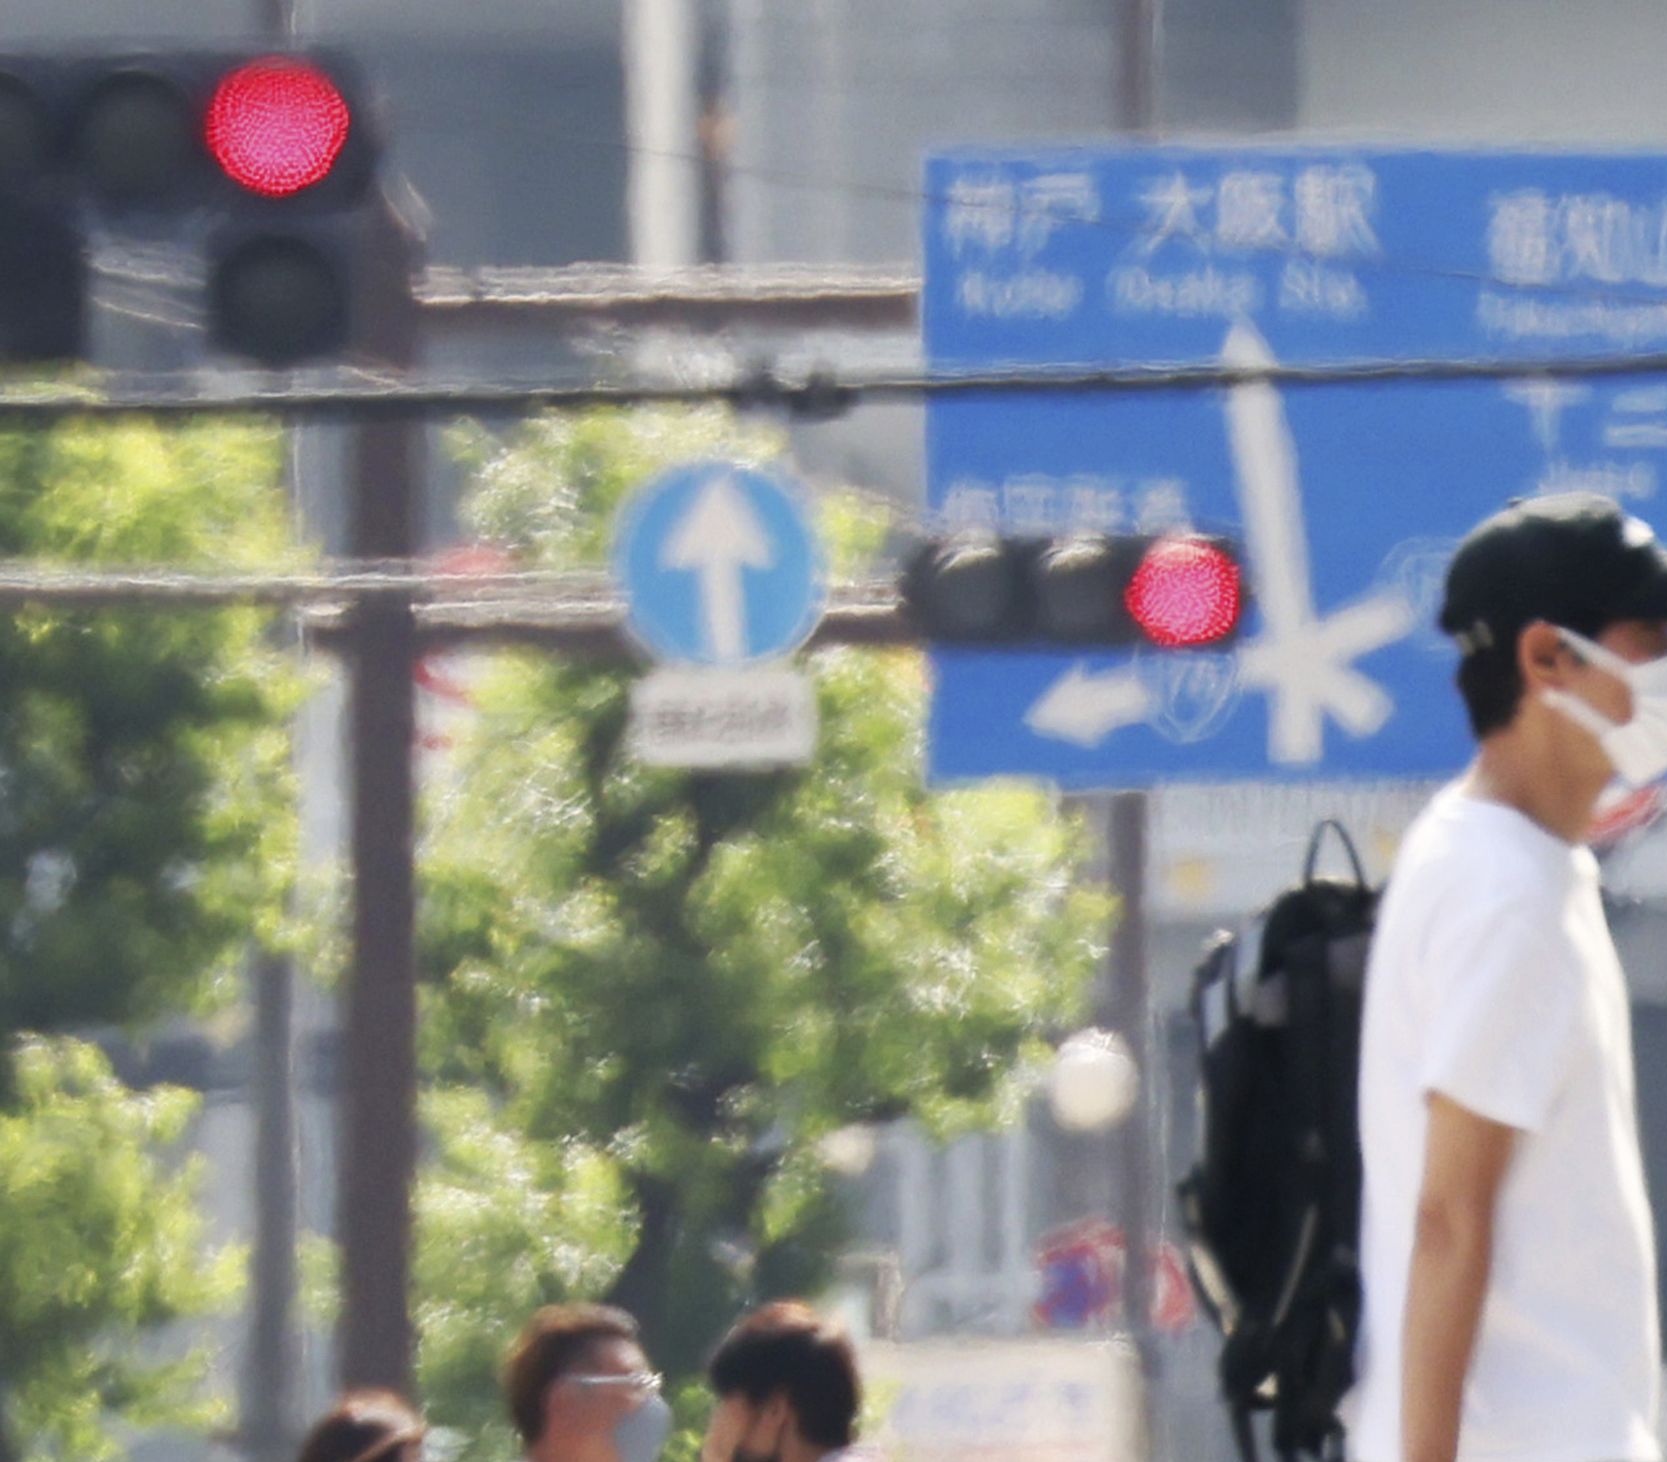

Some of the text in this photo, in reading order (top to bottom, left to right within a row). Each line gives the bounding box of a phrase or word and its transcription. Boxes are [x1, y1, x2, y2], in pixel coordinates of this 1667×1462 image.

[948, 163, 1378, 262] 神戸 大阪駅
